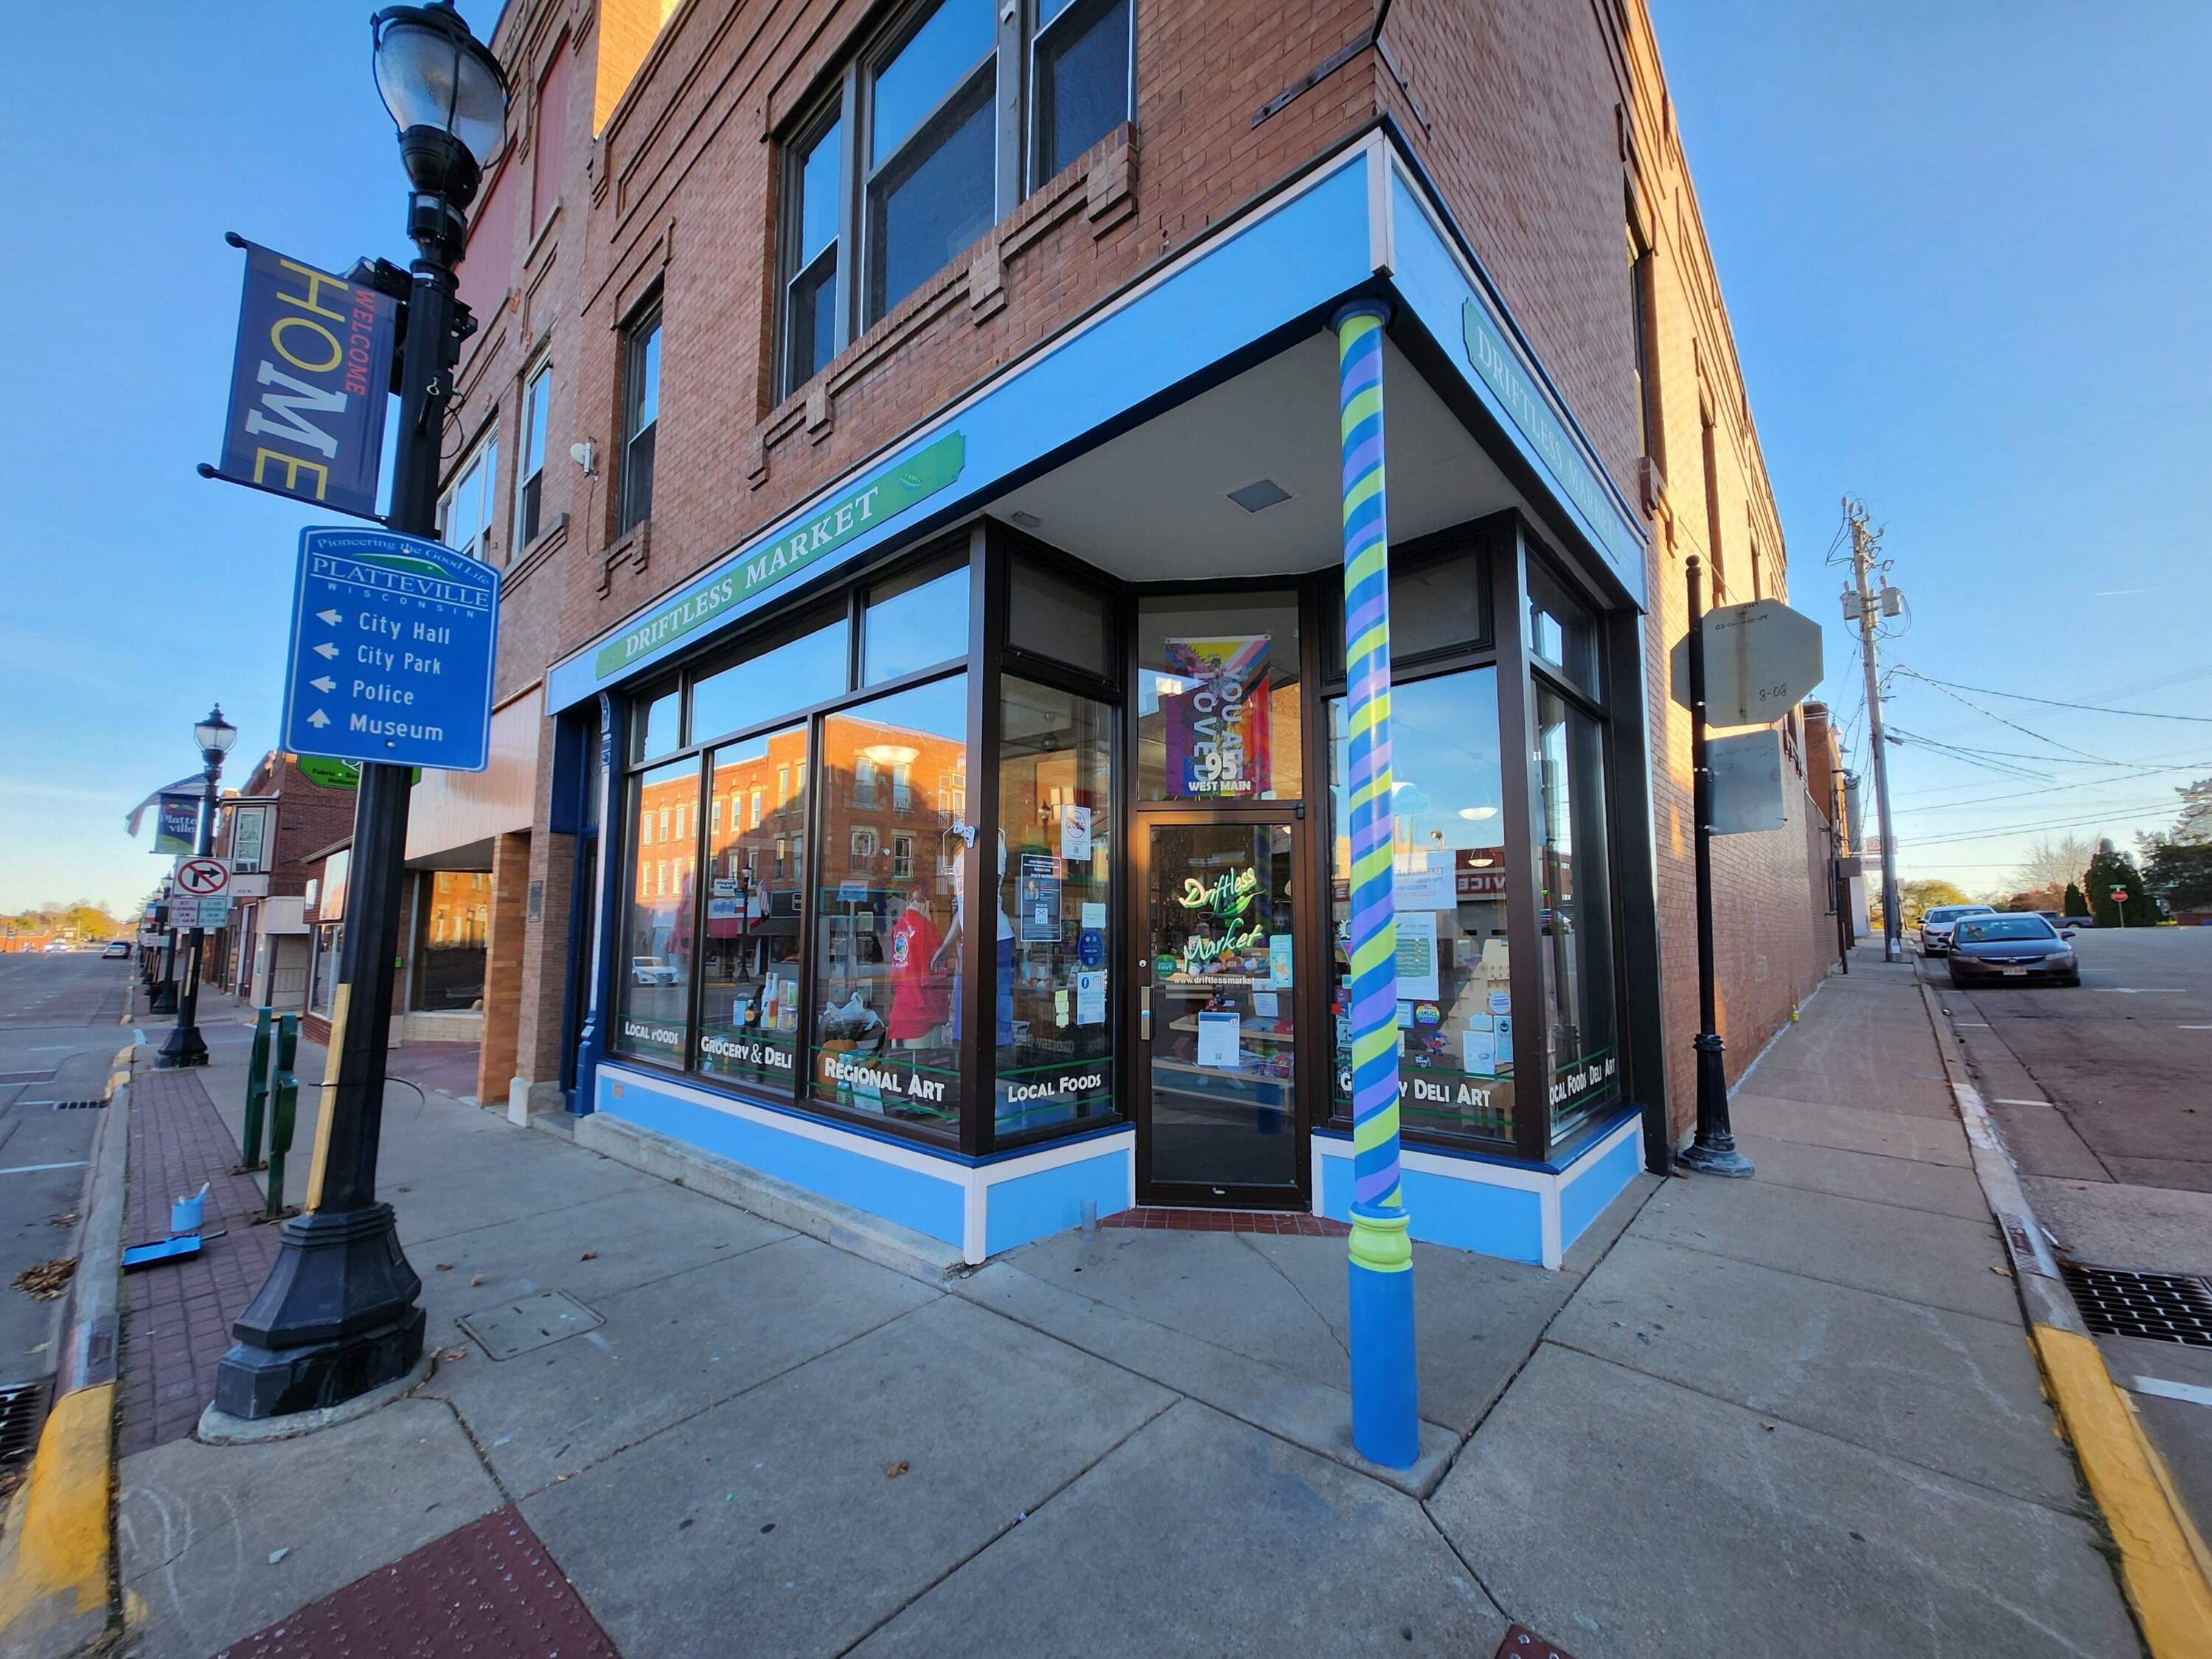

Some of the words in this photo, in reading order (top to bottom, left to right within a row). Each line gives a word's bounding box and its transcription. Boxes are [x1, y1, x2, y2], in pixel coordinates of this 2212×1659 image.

[345, 288, 376, 396] WELCOME
[245, 259, 349, 501] HOME
[1477, 325, 1562, 470] DRIFTLESS
[1568, 459, 1614, 543] MARKET
[317, 537, 397, 550] Pioneering
[400, 543, 422, 554] the
[425, 549, 463, 569] Good
[465, 566, 490, 585] Life
[625, 578, 732, 658] DRIFTLESS
[745, 486, 879, 588] MARKET
[313, 557, 490, 607] PLATTEVILLE
[328, 582, 474, 618] WISCONSIN
[359, 612, 401, 640] City
[413, 622, 450, 644] Hall
[358, 645, 394, 672] City
[404, 653, 441, 675] Park
[352, 680, 414, 705] Police
[1759, 683, 1787, 701] 8-08
[349, 713, 442, 741] Museum
[1206, 752, 1237, 780] 95
[1189, 781, 1219, 792] WEST
[1221, 781, 1251, 792] MAIN
[160, 814, 198, 825] Platte
[170, 824, 195, 833] ville
[1179, 866, 1256, 911] Driftless
[1183, 918, 1263, 972] Market
[625, 1021, 650, 1040] LOCAL
[700, 1036, 749, 1060] GROCERY
[751, 1043, 763, 1064] &
[765, 1046, 793, 1068] DELI
[824, 1057, 902, 1093] REGIONAL
[908, 1074, 945, 1102] ART
[1008, 1082, 1055, 1102] LOCAL
[1060, 1074, 1101, 1093] FOODS
[1414, 1079, 1450, 1102] DELI
[1457, 1083, 1491, 1107] ART
[1549, 1082, 1567, 1105] OCAL
[1568, 1071, 1587, 1096] FOODS
[1589, 1065, 1602, 1085] DELI
[1605, 1057, 1615, 1077] ART
